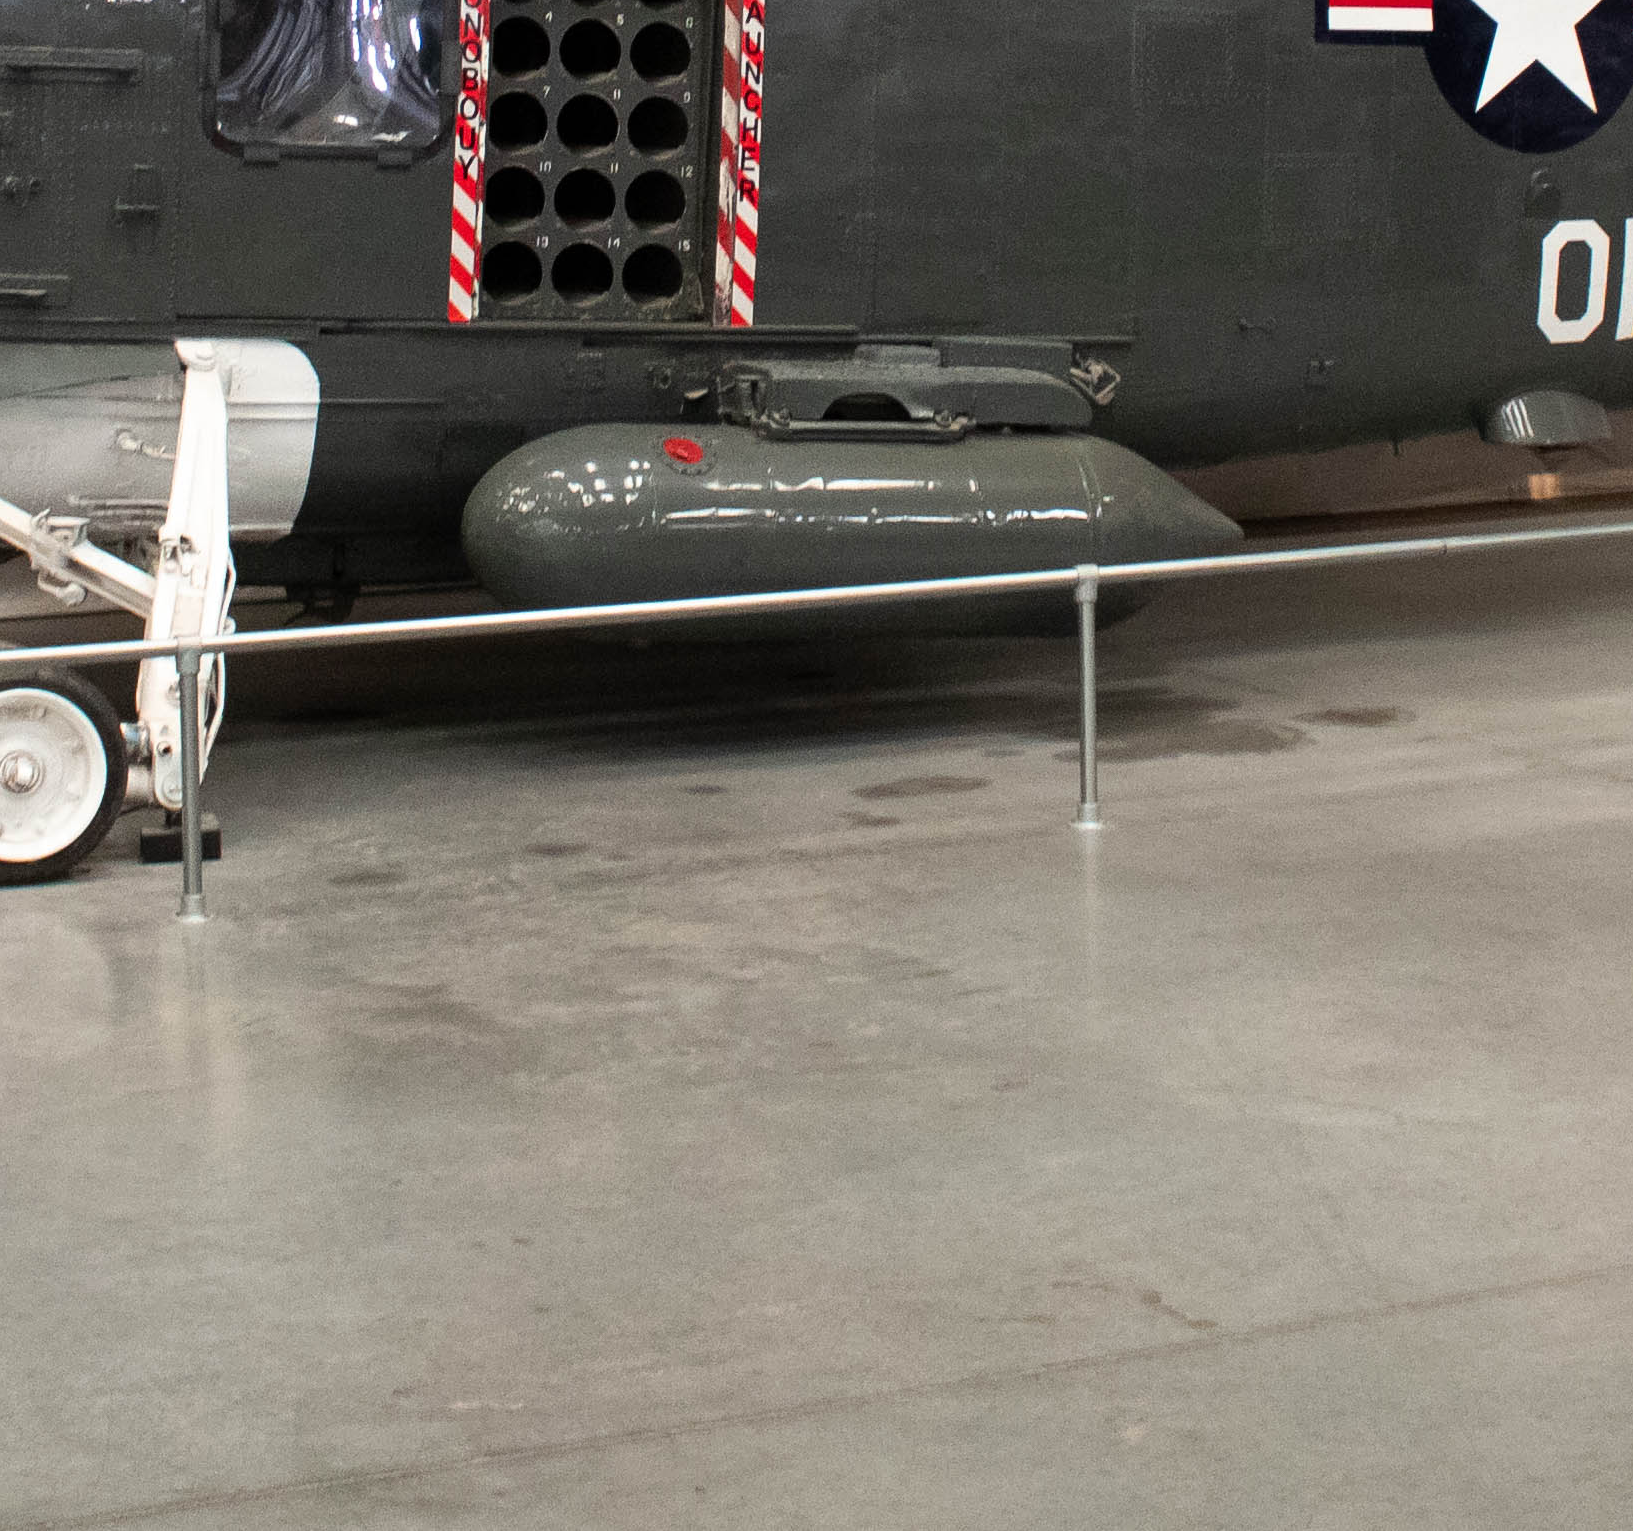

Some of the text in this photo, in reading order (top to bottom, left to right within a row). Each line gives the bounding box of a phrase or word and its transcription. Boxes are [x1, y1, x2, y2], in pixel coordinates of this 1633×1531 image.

[539, 160, 552, 173] 10
[610, 162, 619, 174] 11
[680, 165, 694, 178] 12
